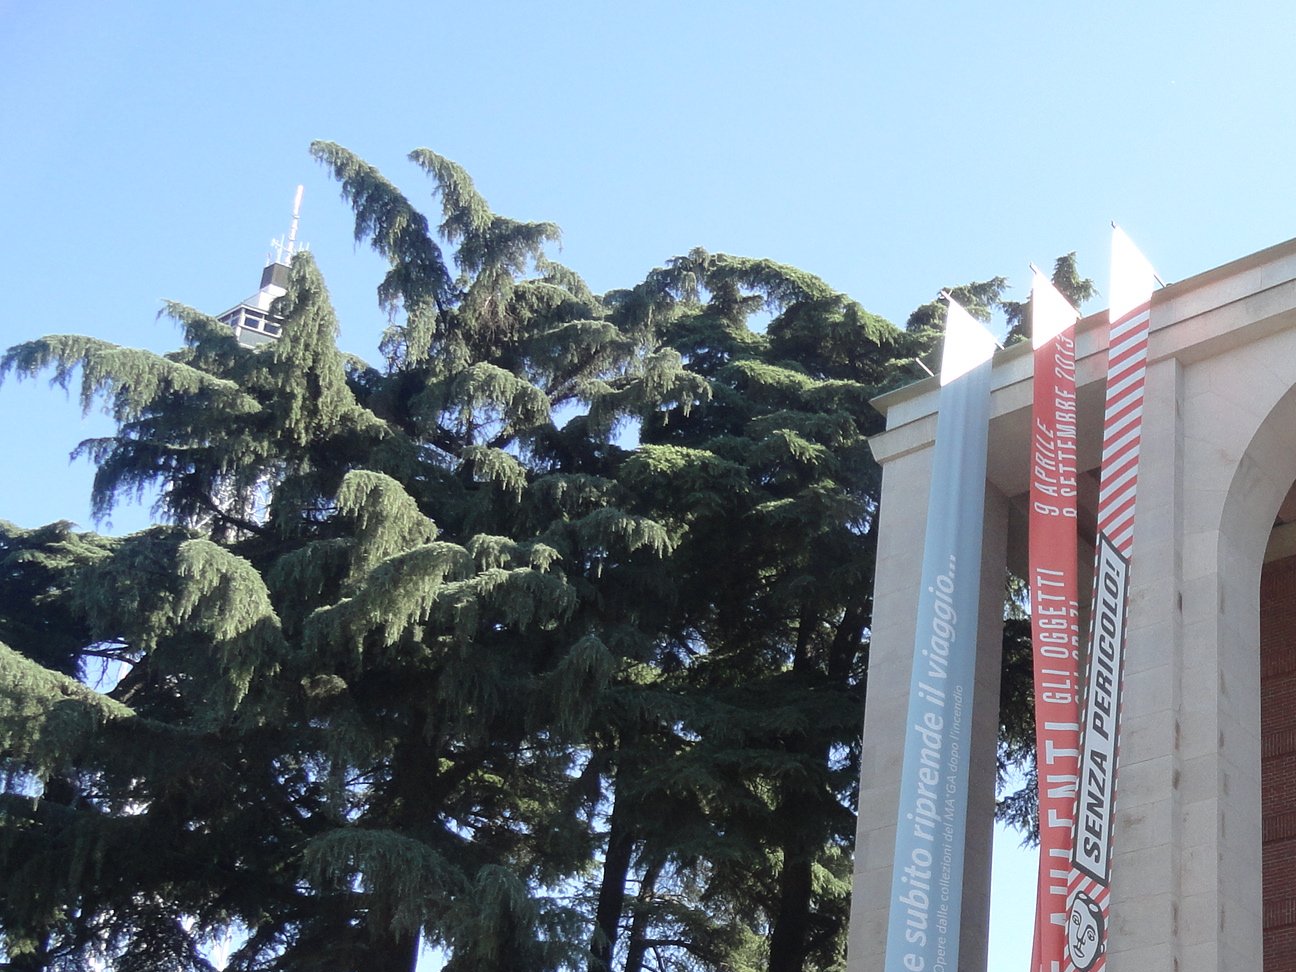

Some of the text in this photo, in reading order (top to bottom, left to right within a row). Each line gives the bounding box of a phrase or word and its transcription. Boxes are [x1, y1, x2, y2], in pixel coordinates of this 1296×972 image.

[1054, 334, 1077, 382] 2013
[1034, 417, 1059, 516] 9 APRILE
[1054, 385, 1077, 497] SETTEMBRE
[1036, 568, 1072, 704] GLI OGGETTI
[950, 685, 964, 741] l'incendio
[1083, 558, 1122, 865] SENZA PERICOLO!
[900, 554, 957, 972] e subito riprende il viaggio...
[948, 743, 962, 774] dopo
[941, 823, 954, 843] del
[937, 845, 952, 902] collezioni
[936, 904, 950, 935] dalle
